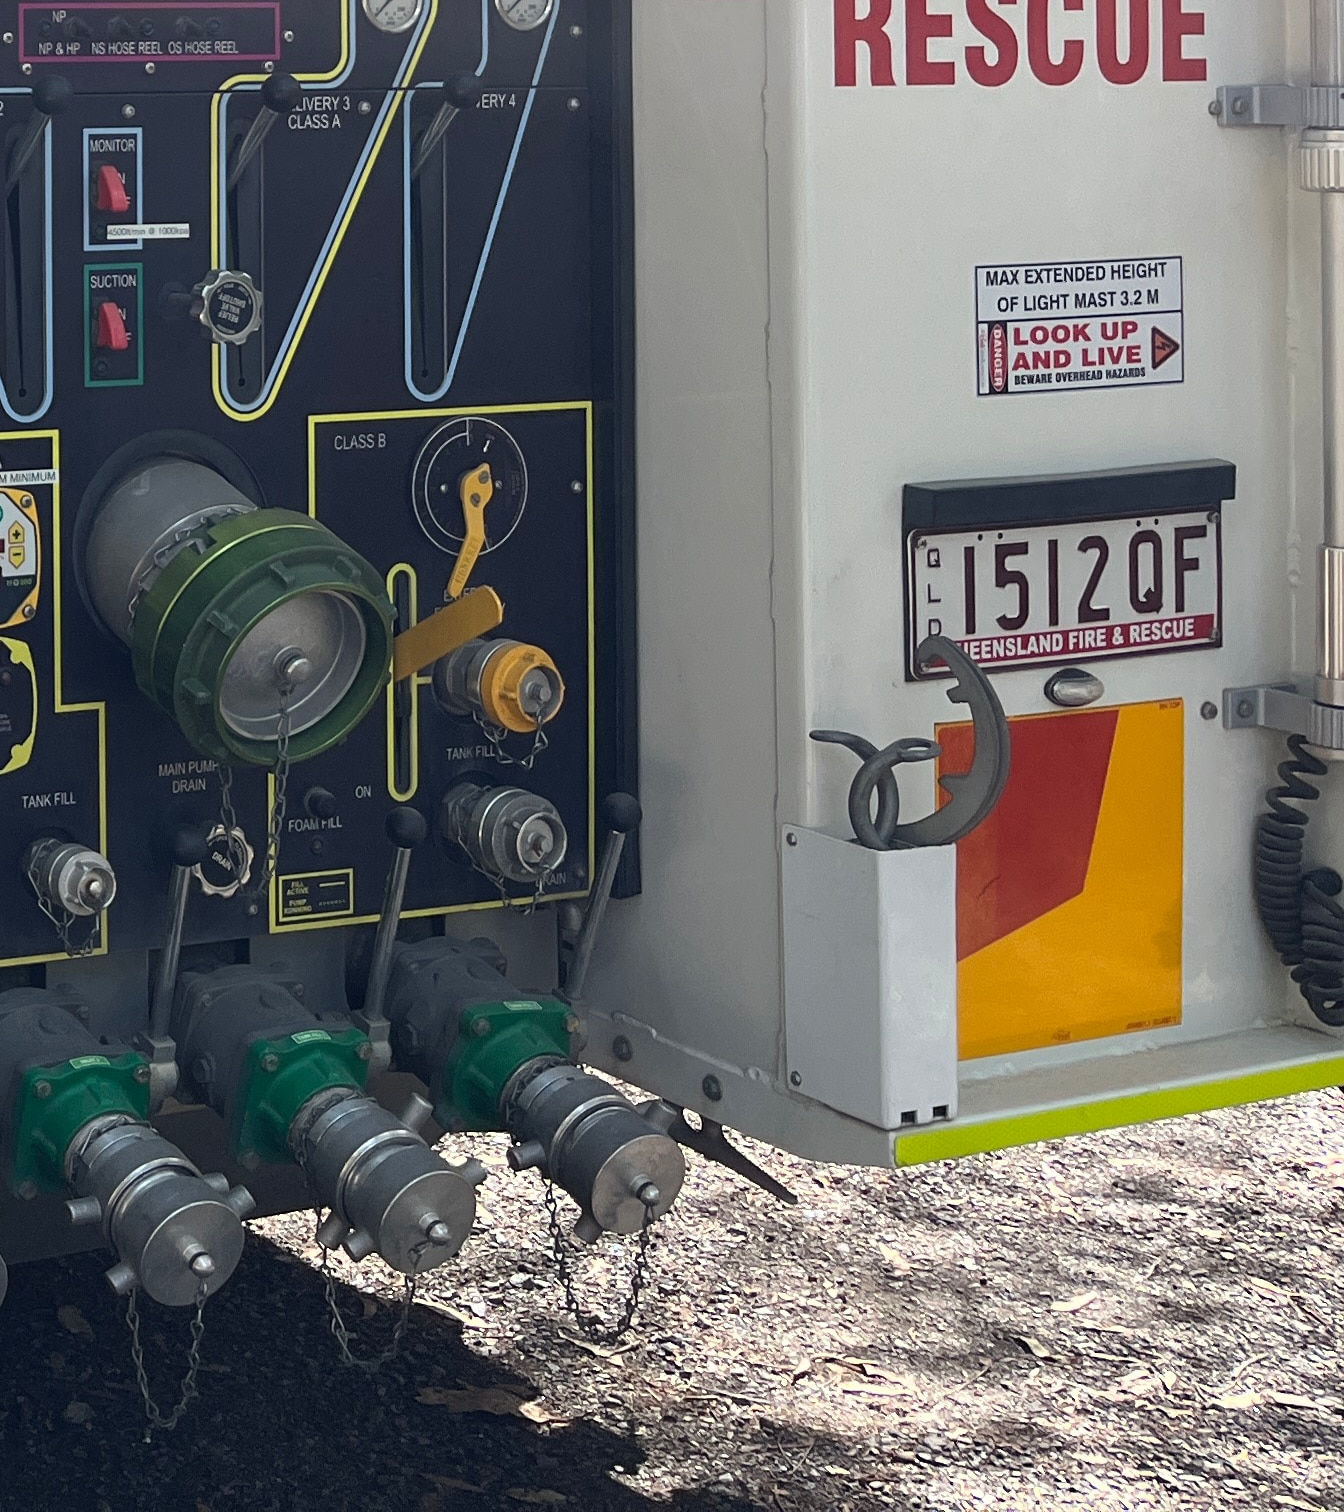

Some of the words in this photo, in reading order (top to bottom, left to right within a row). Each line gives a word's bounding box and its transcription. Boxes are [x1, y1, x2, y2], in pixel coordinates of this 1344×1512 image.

[52, 10, 66, 22] NP
[38, 42, 53, 55] NP
[56, 42, 64, 55] &
[66, 42, 80, 55] HP
[91, 42, 106, 54] NS
[108, 42, 136, 54] HOSE
[138, 42, 163, 54] REEL
[168, 42, 182, 54] OS
[185, 42, 212, 54] HOSE
[214, 42, 239, 54] REEL
[342, 97, 350, 111] 3
[508, 94, 516, 108] 4
[288, 114, 329, 130] CLASS
[332, 114, 341, 128] A
[90, 139, 136, 152] MONITOR
[90, 275, 136, 288] SUCTION
[986, 270, 1020, 287] MAX
[1024, 265, 1106, 284] EXTENDED
[1110, 262, 1167, 280] HEIGHT
[997, 296, 1019, 312] OF
[1024, 294, 1070, 311] LIGHT
[1074, 292, 1116, 309] MAST
[1120, 290, 1143, 306] 3.2
[1147, 289, 1160, 304] M
[1013, 323, 1092, 346] LOOK
[1100, 320, 1139, 340] UP
[994, 330, 1002, 386] DANGER
[1012, 350, 1077, 371] AND
[1082, 345, 1142, 367] LIVE
[1014, 372, 1053, 386] BEWARE
[1055, 369, 1103, 383] OVERHEAD
[1105, 367, 1146, 380] HAZARDS
[334, 435, 374, 451] CLASS
[378, 433, 386, 448] B
[10, 471, 56, 484] MINIMUM
[927, 548, 942, 637] QLD
[1068, 628, 1106, 650] FIRE
[1112, 628, 1124, 645] &
[1128, 618, 1195, 642] RESCUE
[446, 748, 472, 760] TANK
[476, 746, 496, 758] FILL
[159, 762, 186, 777] MAIN
[172, 778, 206, 794] DRAIN
[355, 786, 372, 799] ON
[22, 794, 52, 808] TANK
[54, 792, 76, 806] FILL
[288, 818, 320, 833] FOAM
[322, 816, 342, 829] FILL
[212, 852, 232, 872] DRAIN
[286, 888, 310, 896] ACTIVE
